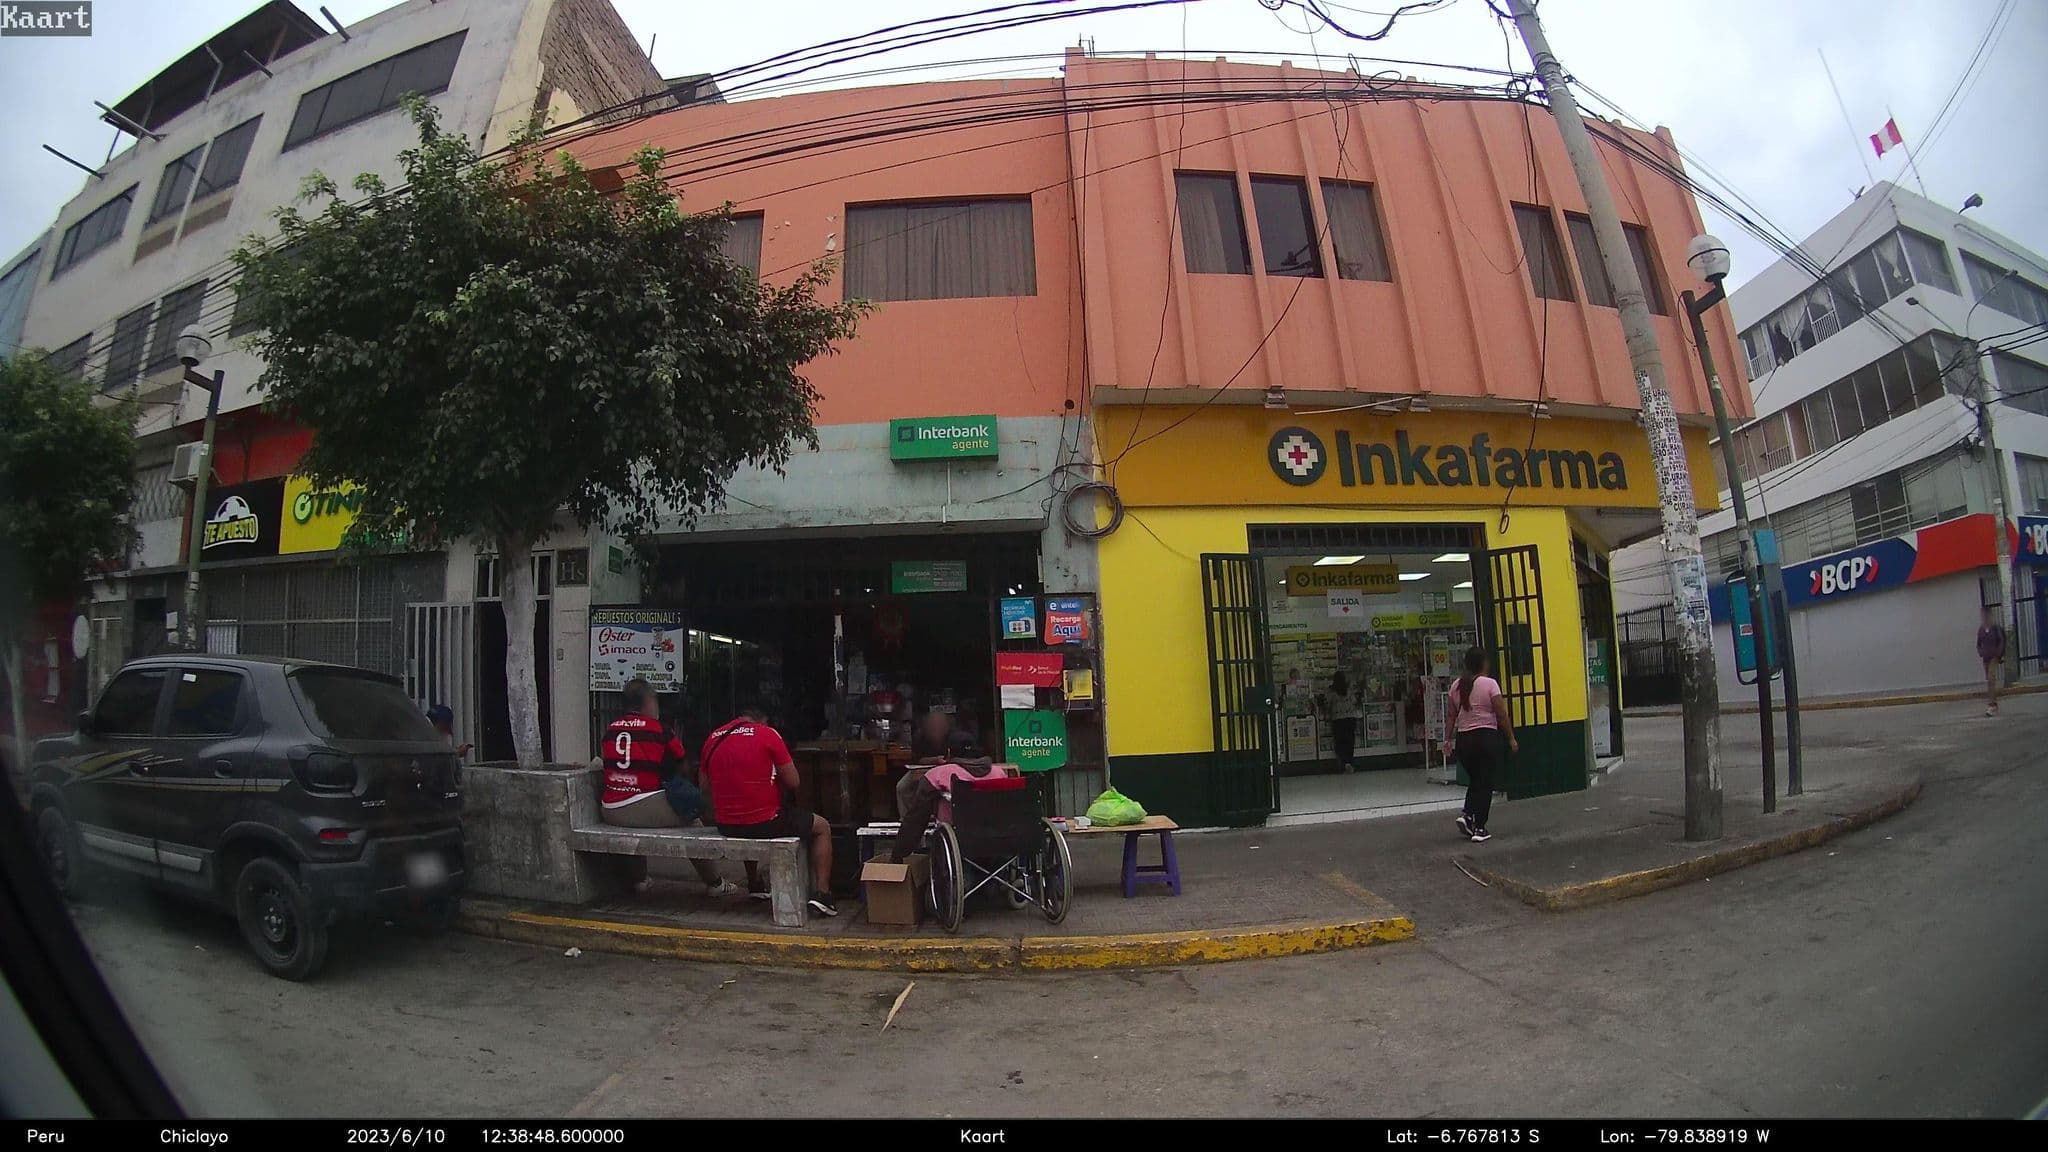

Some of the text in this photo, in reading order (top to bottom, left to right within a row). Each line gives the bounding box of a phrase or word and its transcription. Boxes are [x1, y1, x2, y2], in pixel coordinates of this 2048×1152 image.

[919, 424, 989, 439] Interbank
[952, 440, 990, 452] agente
[1335, 429, 1629, 491] Inkafarma
[310, 488, 367, 517] TINK
[206, 517, 256, 545] TE APUESTO
[1312, 572, 1395, 587] Inkafarma
[1821, 556, 1866, 595] BCP
[1330, 598, 1360, 606] SALIDA
[592, 612, 634, 624] REPUESTOS
[1050, 616, 1081, 624] Recarga
[599, 627, 635, 643] Oster
[1008, 736, 1063, 747] Interbank
[615, 731, 632, 769] 9
[1022, 748, 1051, 758] agente
